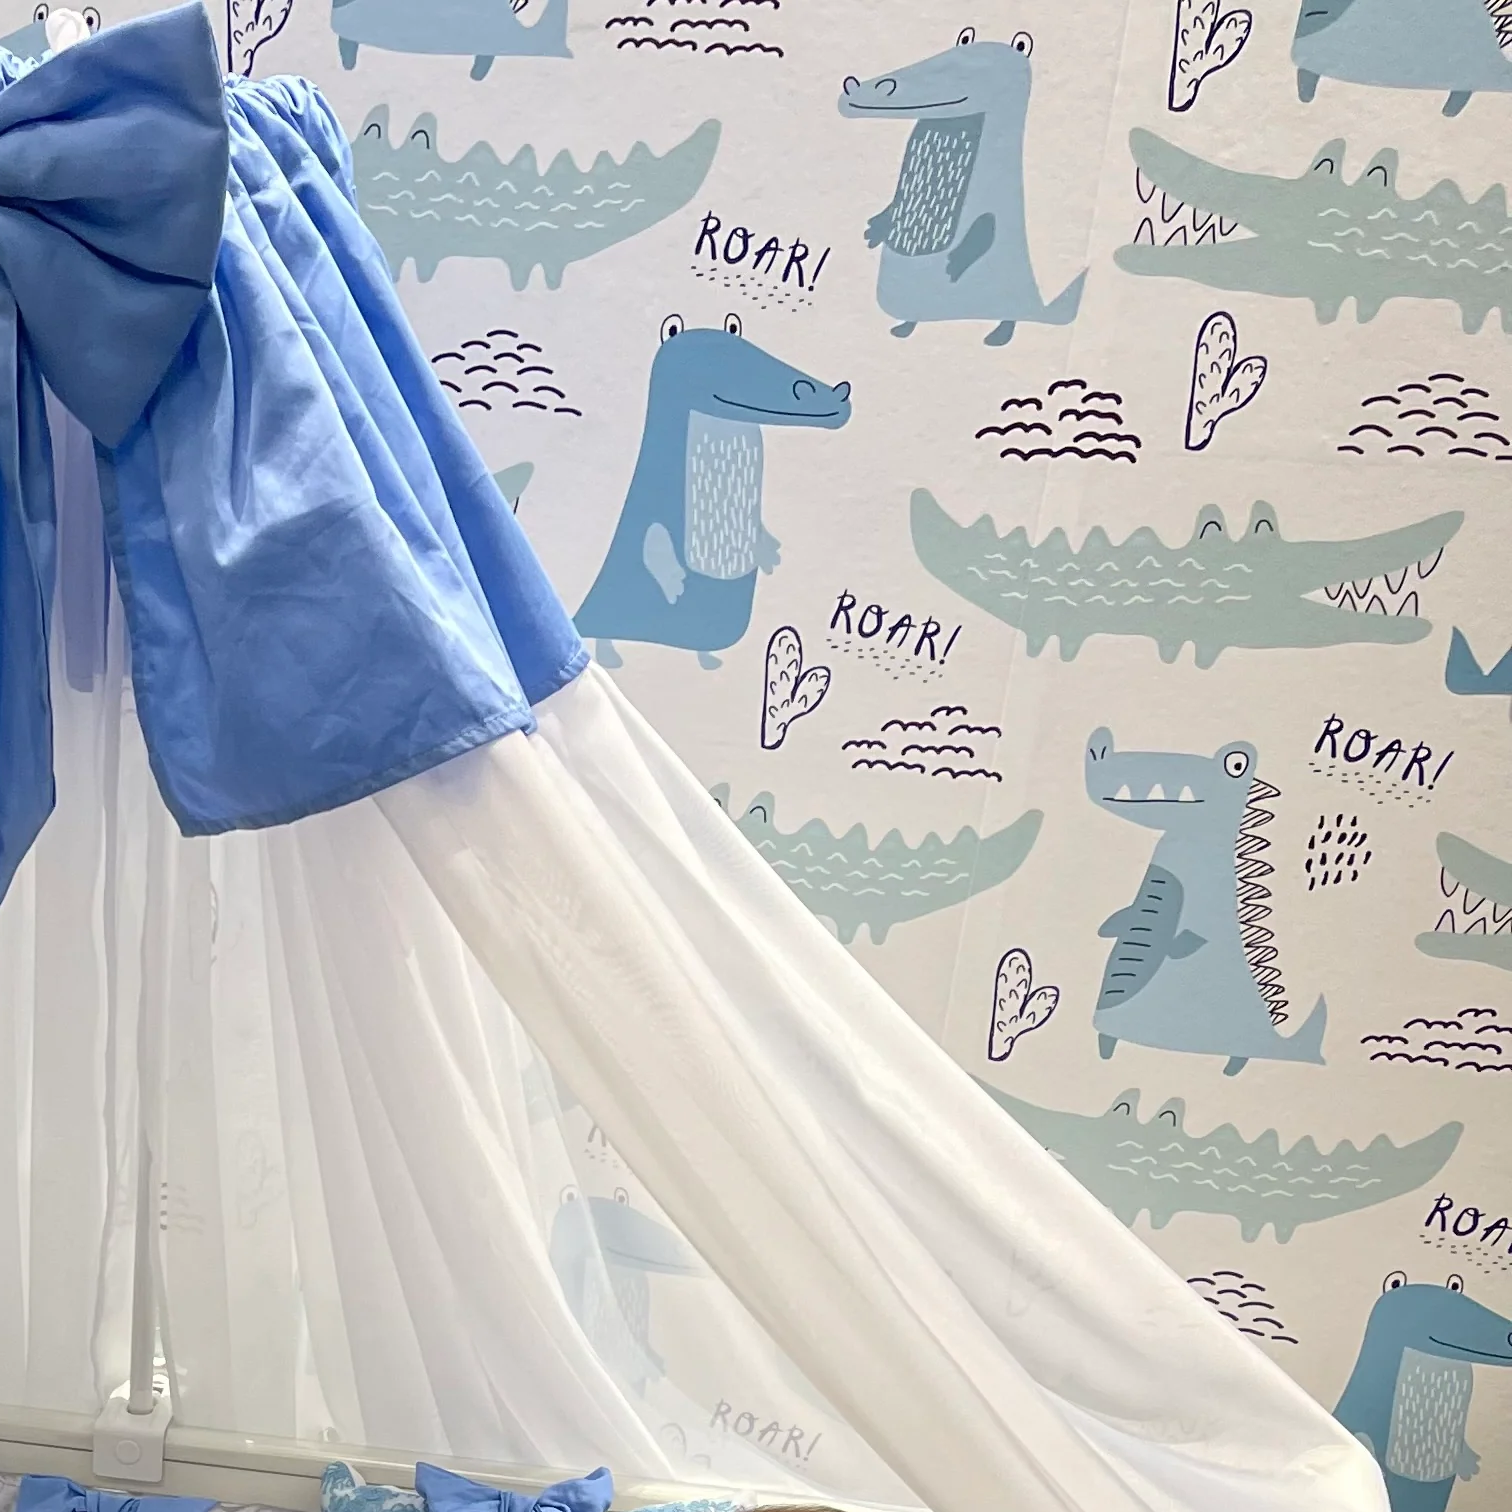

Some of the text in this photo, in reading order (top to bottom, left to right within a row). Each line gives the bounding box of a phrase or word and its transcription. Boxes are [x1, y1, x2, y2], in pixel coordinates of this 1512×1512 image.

[694, 210, 831, 292] ROAR!
[830, 589, 962, 665] ROAR!
[1314, 713, 1455, 790] ROAR!
[1424, 1192, 1512, 1254] ROA
[708, 1398, 823, 1462] ROAR!
